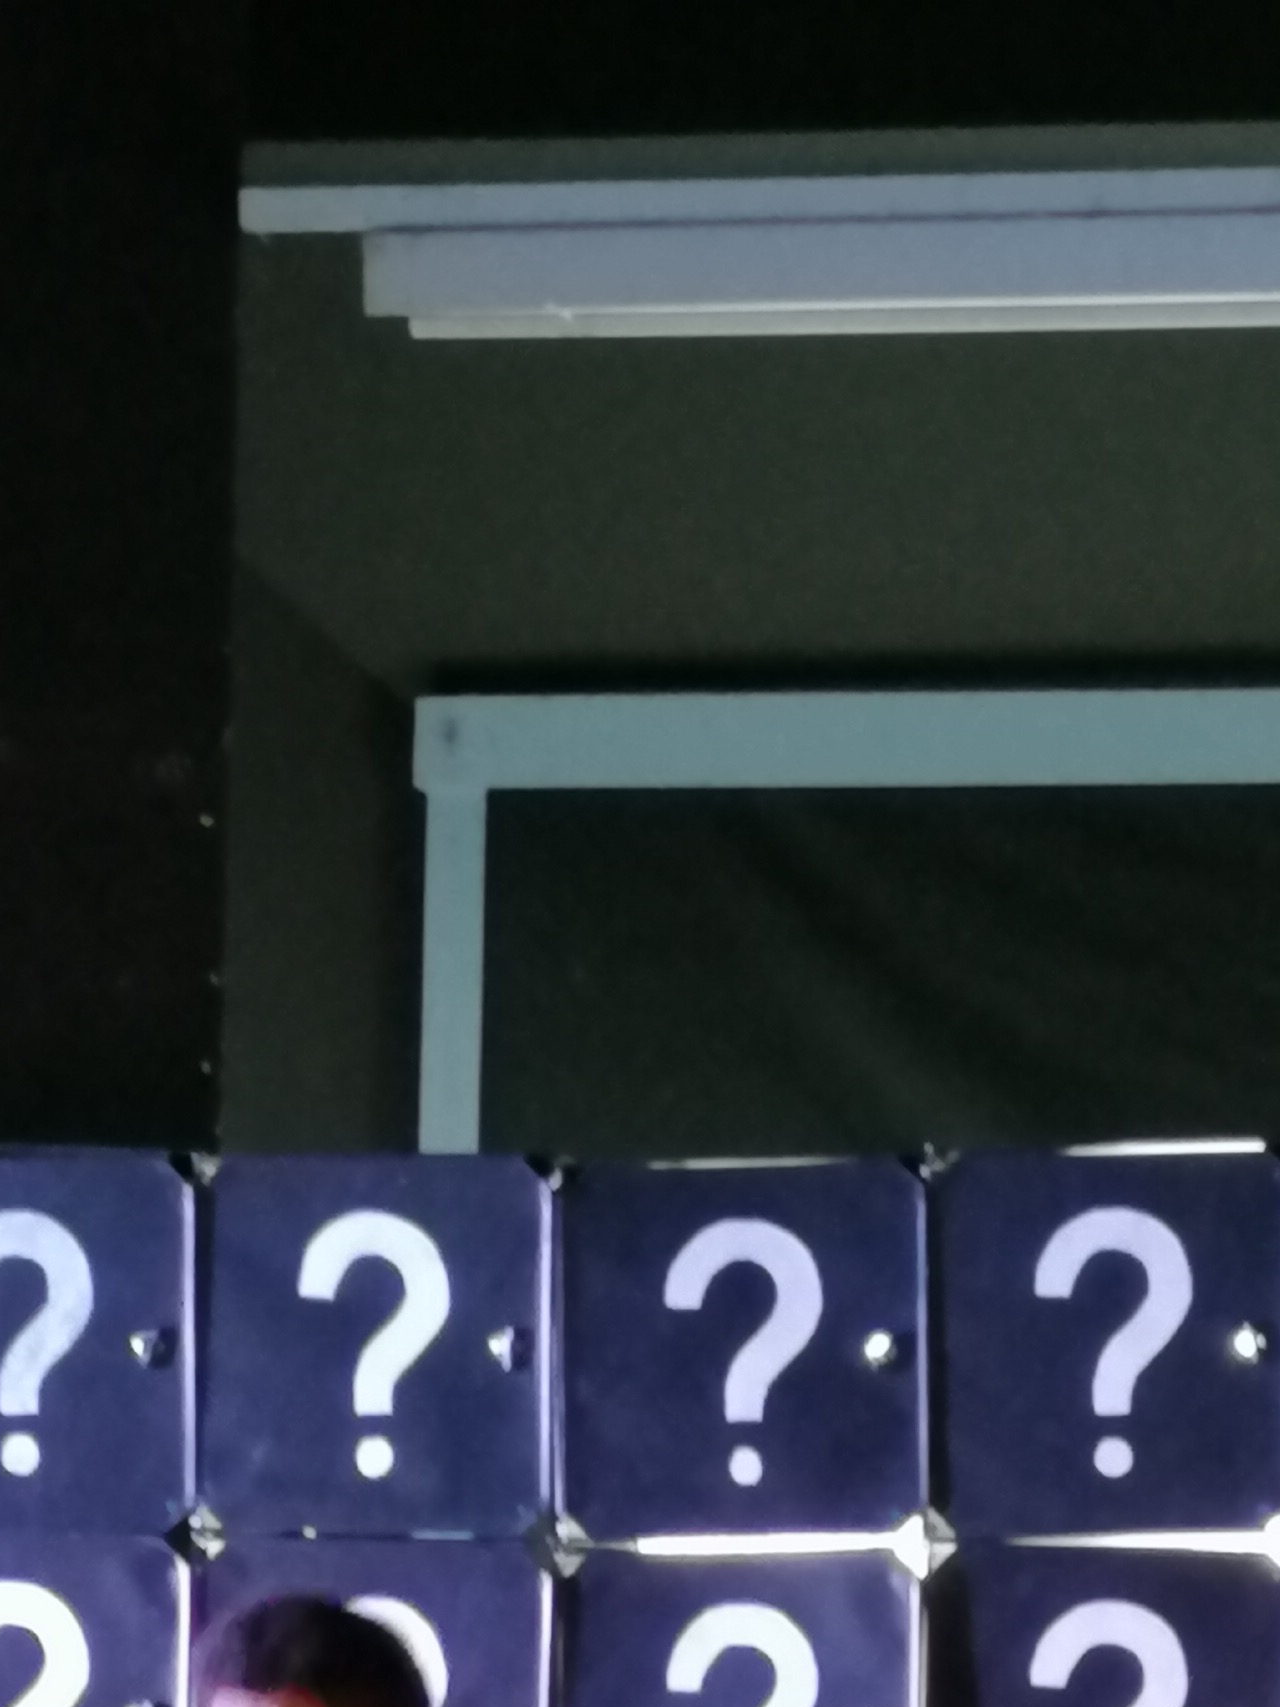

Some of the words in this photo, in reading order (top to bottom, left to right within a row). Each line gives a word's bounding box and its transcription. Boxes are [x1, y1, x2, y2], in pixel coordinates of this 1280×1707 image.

[297, 1209, 451, 1479] ?
[664, 1218, 823, 1486] ?
[1034, 1206, 1193, 1478] ?
